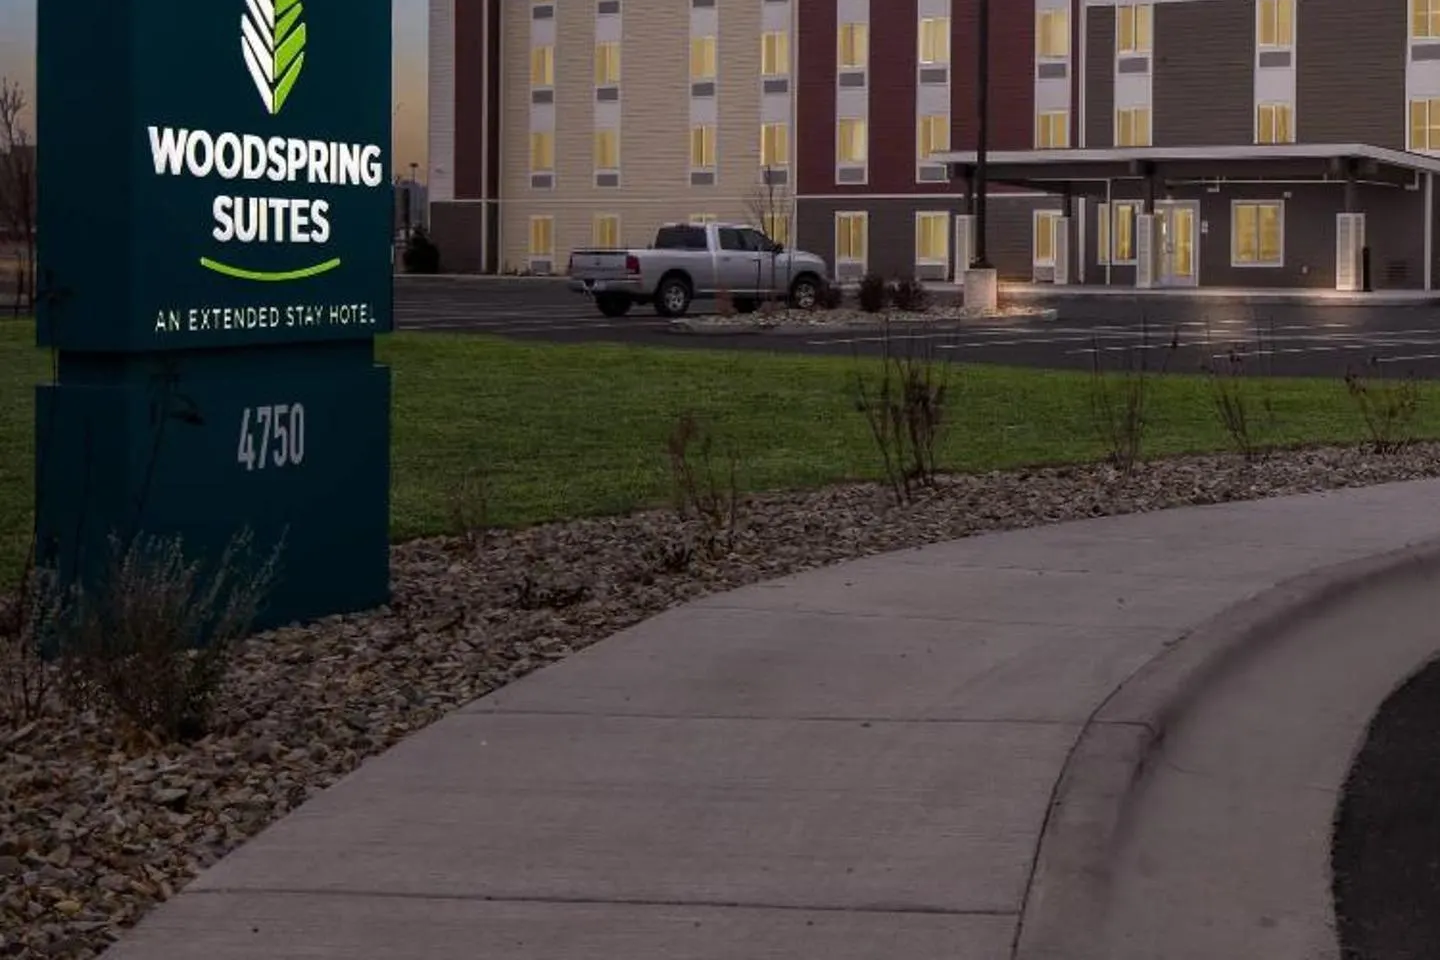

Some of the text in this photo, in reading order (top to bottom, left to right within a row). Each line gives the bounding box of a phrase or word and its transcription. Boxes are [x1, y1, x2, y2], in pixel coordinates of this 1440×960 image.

[147, 126, 383, 186] WOODSPRING
[212, 195, 330, 242] SUITES
[155, 310, 181, 332] AN
[188, 308, 279, 330] EXTENDED
[286, 306, 324, 327] STAY
[237, 402, 305, 471] 4750
